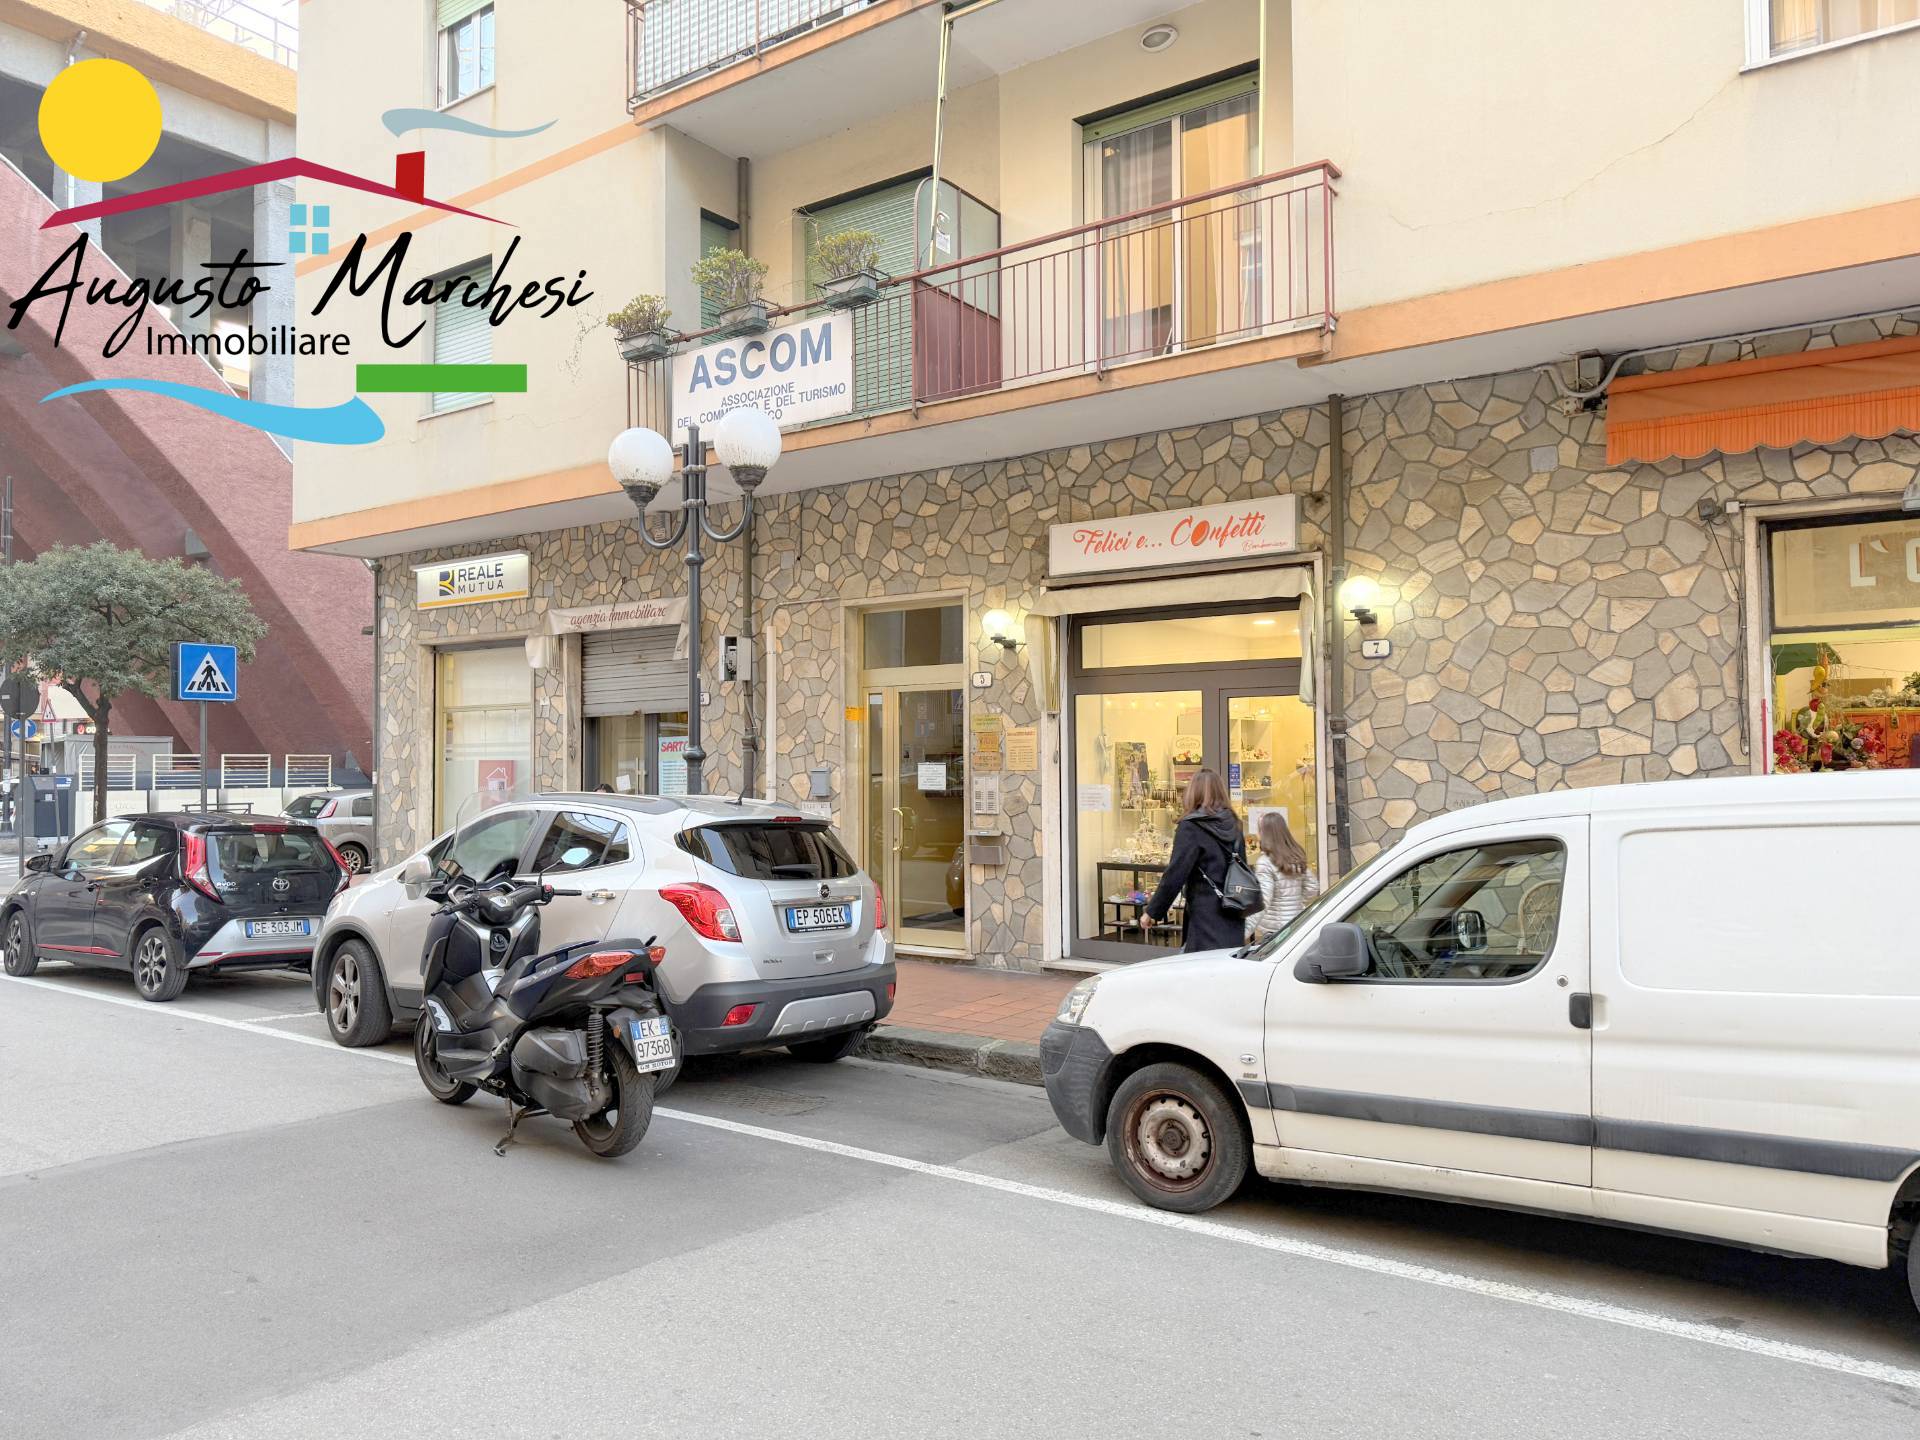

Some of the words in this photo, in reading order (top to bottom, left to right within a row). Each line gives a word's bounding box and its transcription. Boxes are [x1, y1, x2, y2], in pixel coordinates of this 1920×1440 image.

[689, 322, 832, 393] ASCOM
[721, 382, 795, 408] ASSOCIAZIONE
[764, 399, 770, 411] E
[776, 394, 796, 408] DEL
[799, 382, 846, 402] TURISMO
[1073, 529, 1131, 555] Felici
[458, 563, 504, 582] REALE
[458, 579, 504, 595] MUTUA
[571, 610, 606, 629] agenzia
[609, 604, 667, 622] immobiliare
[1373, 642, 1379, 654] 7
[796, 909, 809, 925] EP
[813, 907, 845, 924] 506EK
[254, 922, 267, 934] GE
[271, 921, 303, 933] 303JM
[640, 1020, 655, 1037] EK
[637, 1039, 671, 1058] 97368
